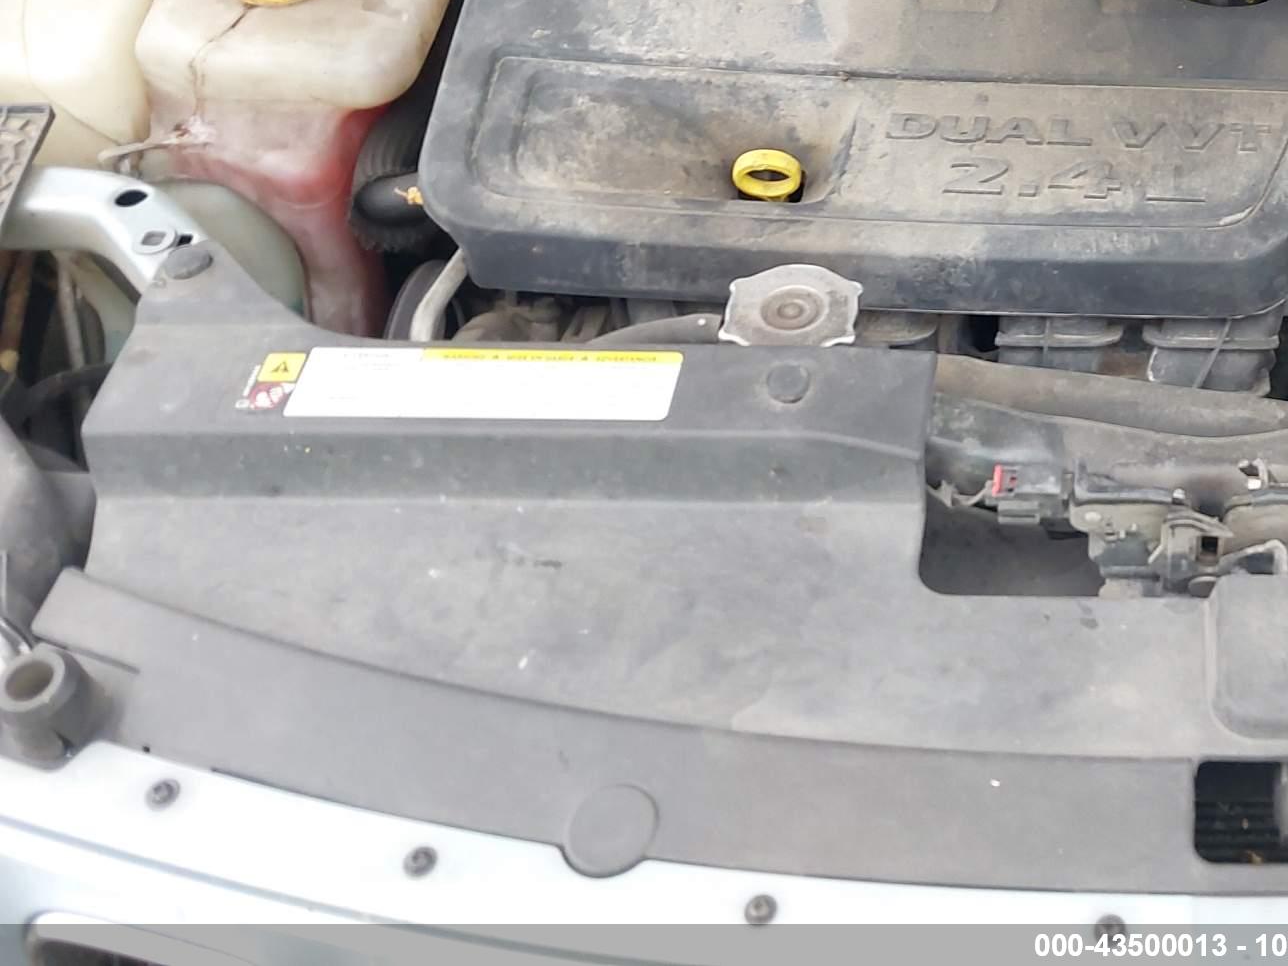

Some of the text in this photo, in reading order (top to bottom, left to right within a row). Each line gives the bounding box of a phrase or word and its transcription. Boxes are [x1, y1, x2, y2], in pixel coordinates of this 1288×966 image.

[885, 112, 1272, 153] DUAL VVT
[942, 156, 1206, 203] 2.4L
